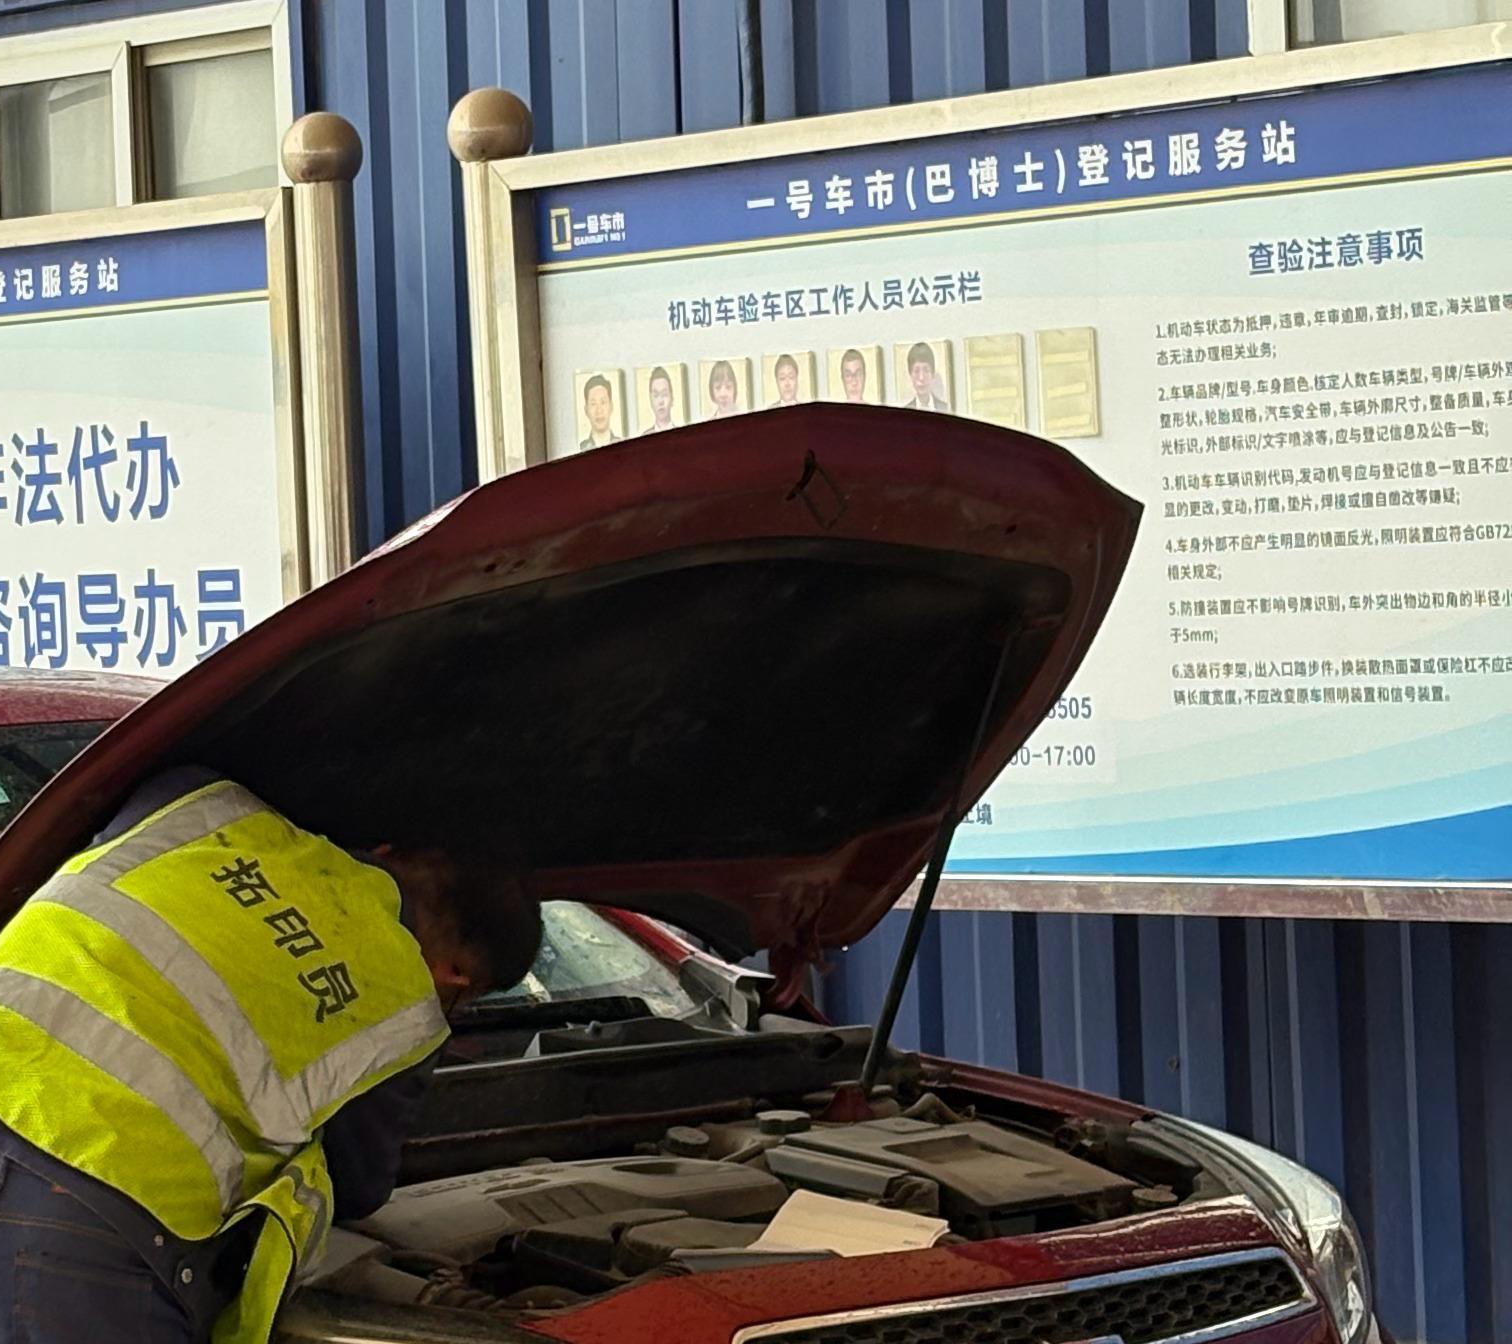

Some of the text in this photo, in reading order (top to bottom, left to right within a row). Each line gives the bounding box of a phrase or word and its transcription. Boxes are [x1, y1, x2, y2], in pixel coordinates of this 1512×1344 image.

[1248, 227, 1424, 276] 查验注意事项
[668, 271, 982, 331] 机动车验车区工作人员公示栏
[209, 855, 360, 1024] 拓印员
